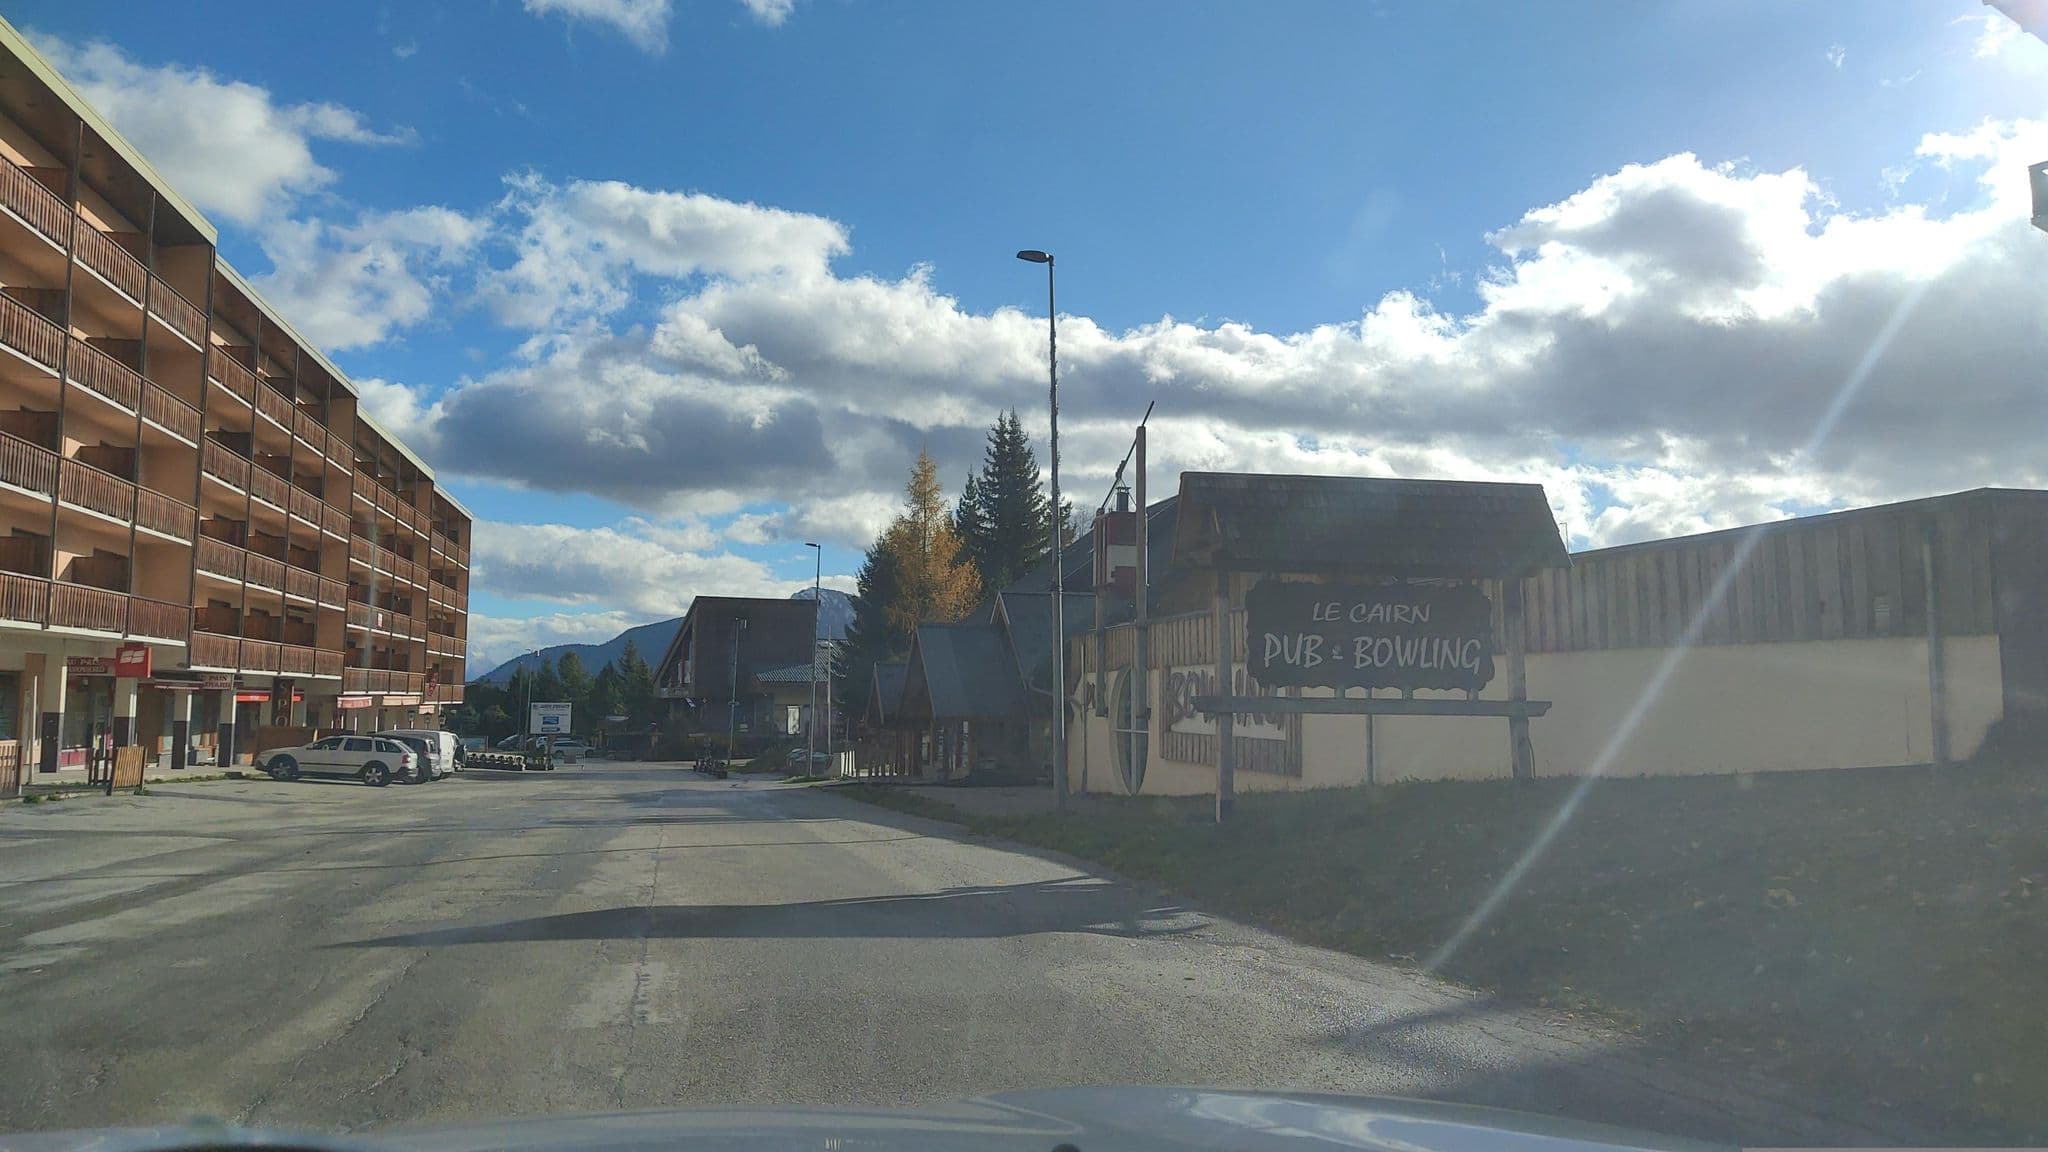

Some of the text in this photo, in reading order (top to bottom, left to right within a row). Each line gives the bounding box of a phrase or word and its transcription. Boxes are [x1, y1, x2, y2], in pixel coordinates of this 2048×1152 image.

[1312, 601, 1431, 624] LE CAIRN
[1263, 632, 1325, 669] PUB
[1353, 634, 1482, 674] BOWLING
